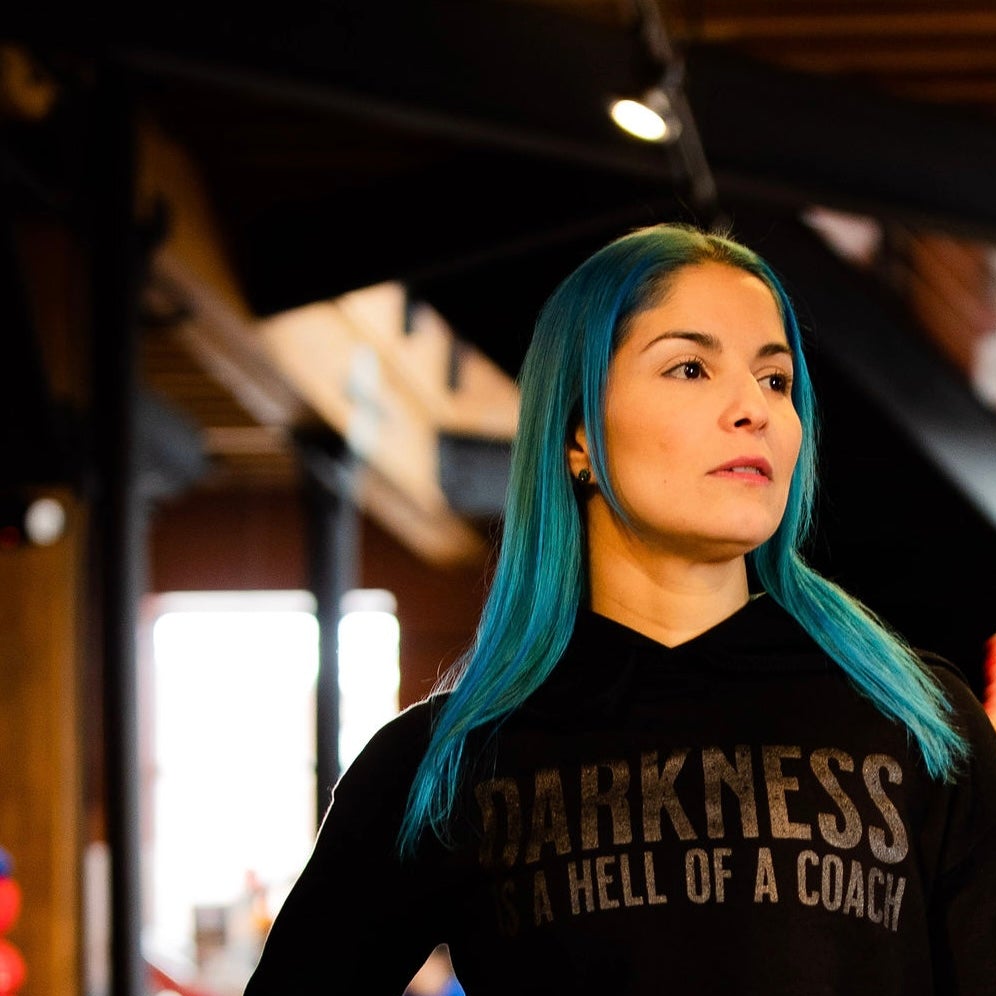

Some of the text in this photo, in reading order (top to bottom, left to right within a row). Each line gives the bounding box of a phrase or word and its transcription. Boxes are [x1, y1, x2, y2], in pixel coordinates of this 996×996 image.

[474, 744, 910, 868] DARKNESS
[532, 869, 554, 927] A
[567, 850, 667, 915] HELL
[685, 847, 732, 904] OF
[753, 846, 779, 903] A
[796, 849, 906, 932] COACH
